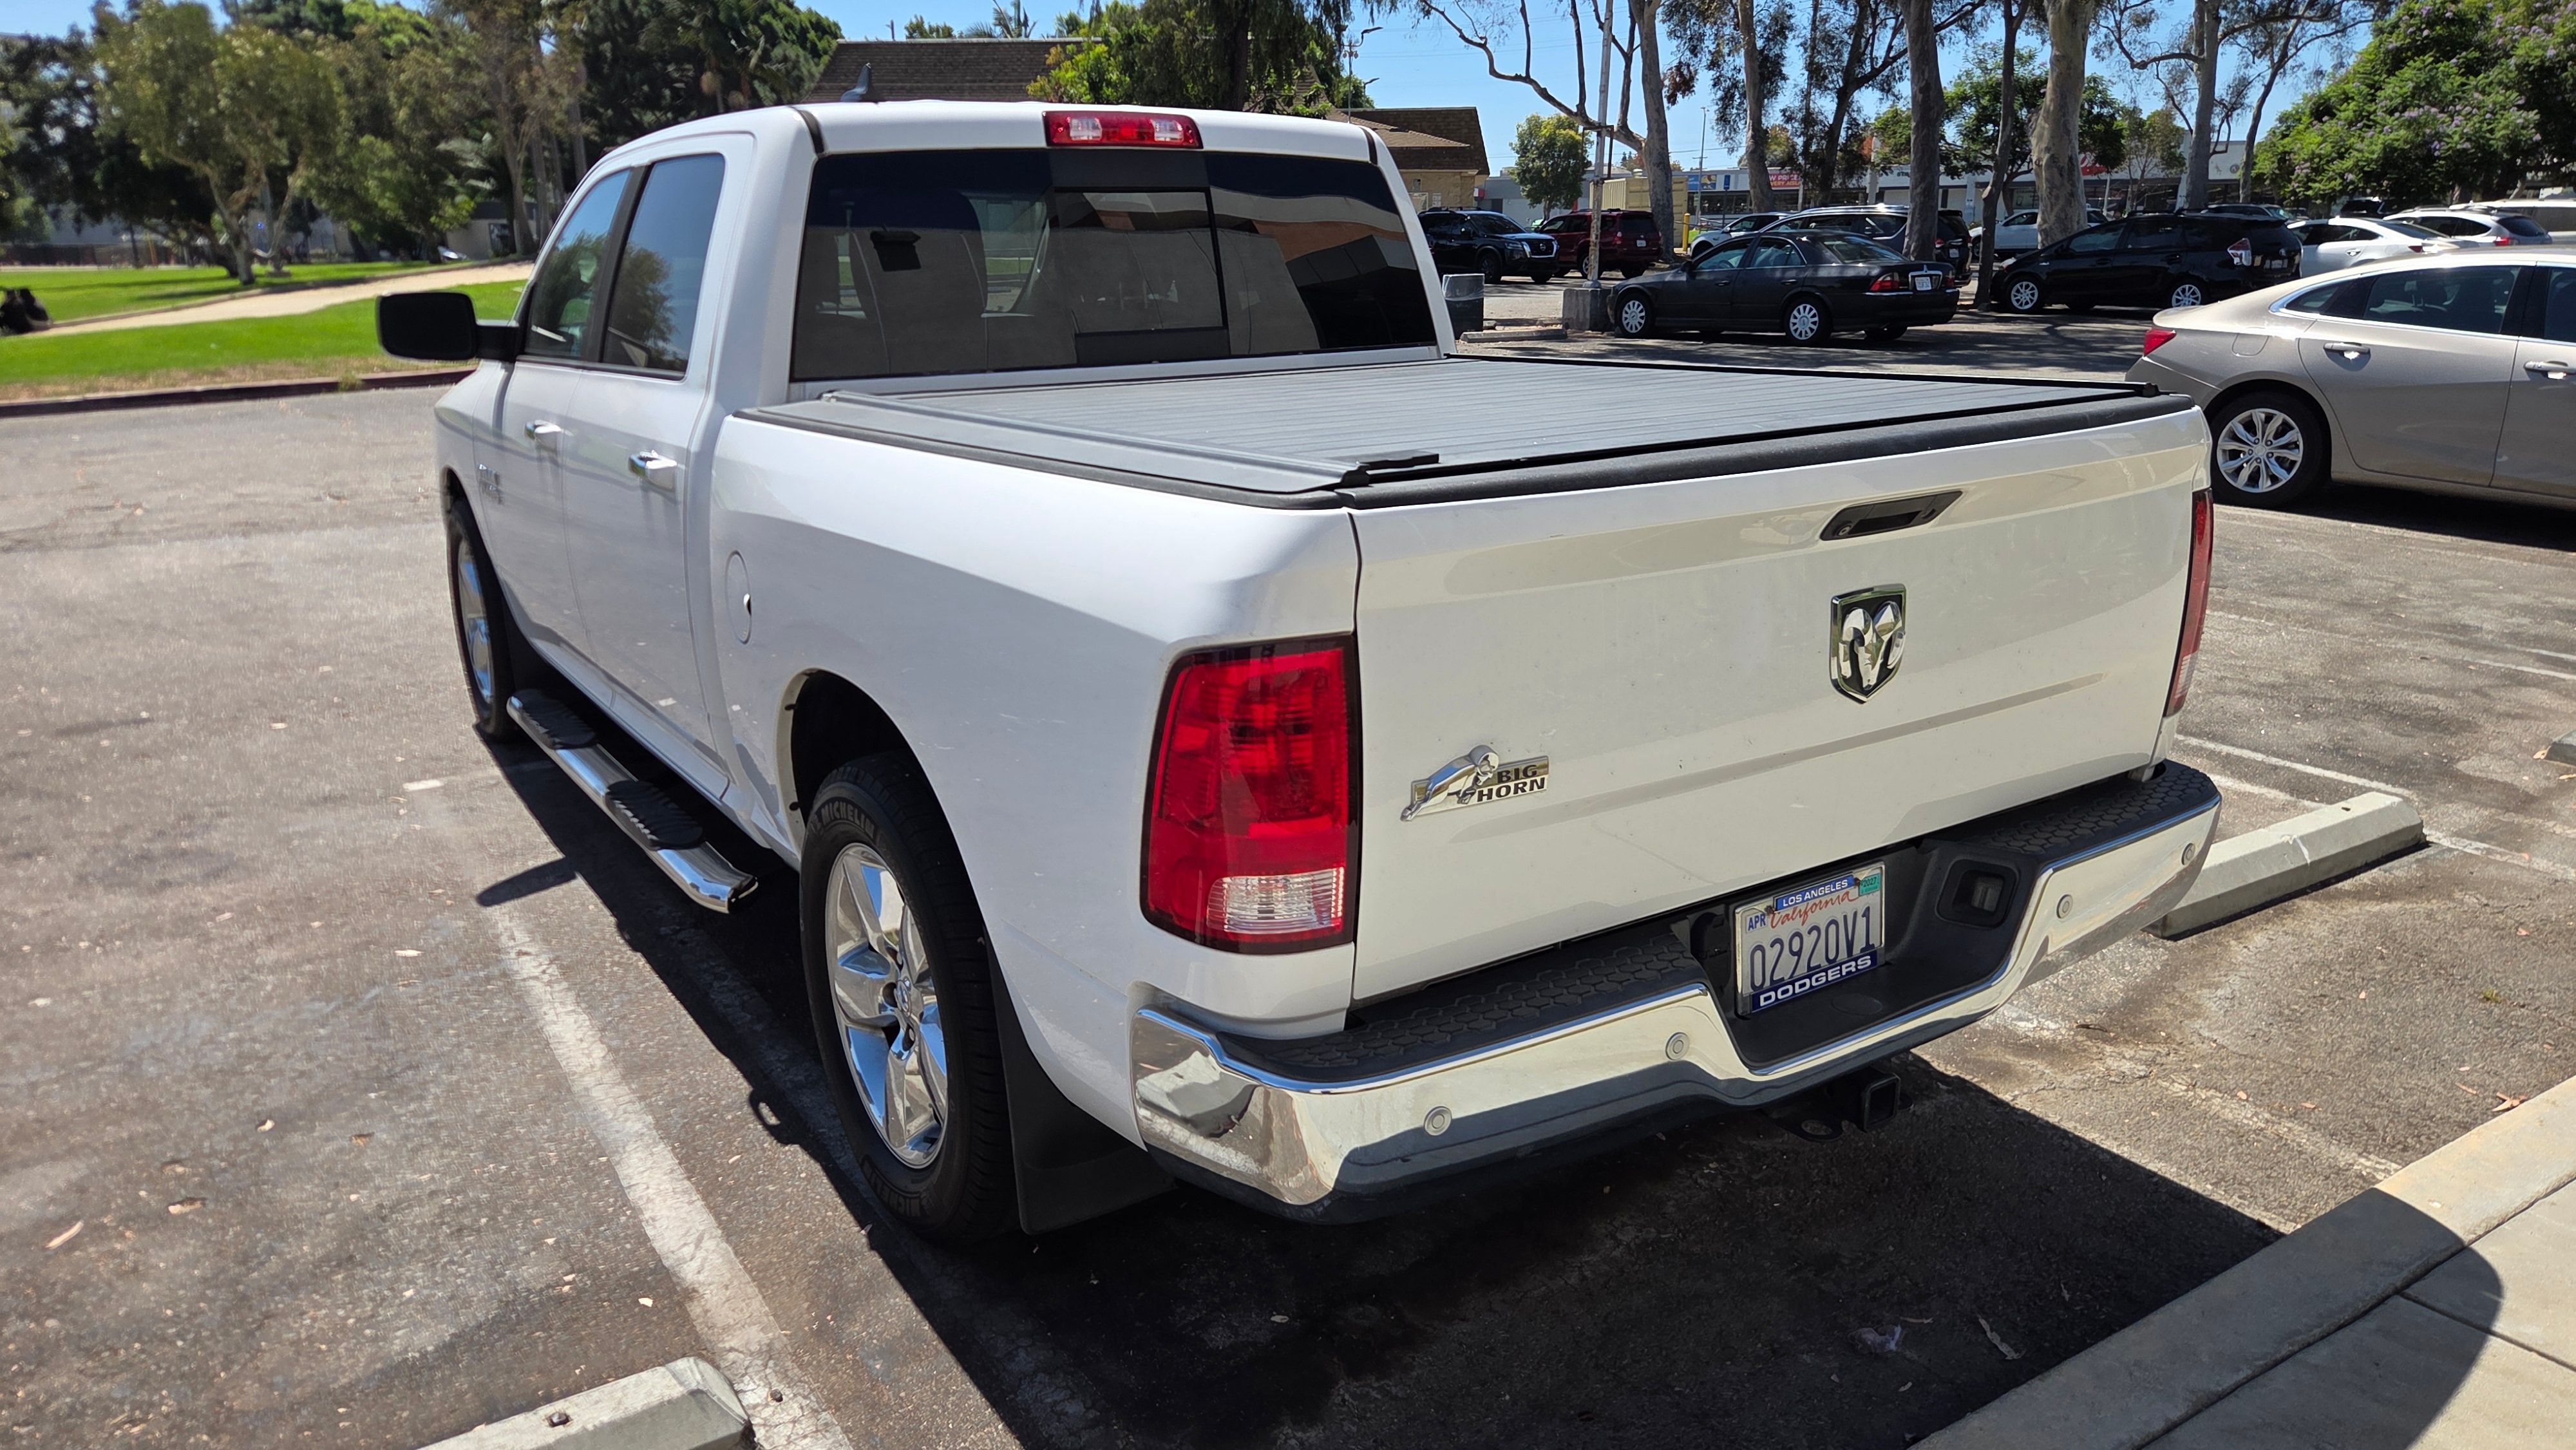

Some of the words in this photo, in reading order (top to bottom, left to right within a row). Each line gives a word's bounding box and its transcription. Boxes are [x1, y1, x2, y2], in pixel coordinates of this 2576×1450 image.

[1477, 777, 1546, 802] HORN
[1497, 764, 1538, 784] BIG
[820, 800, 875, 839] MICHELIN
[1770, 890, 1860, 929] California
[1783, 894, 1803, 907] LOS
[1804, 879, 1848, 901] ANGELES
[1747, 913, 1766, 931] APR
[1750, 905, 1876, 992] 02920V1
[1759, 955, 1871, 1007] DODGERS
